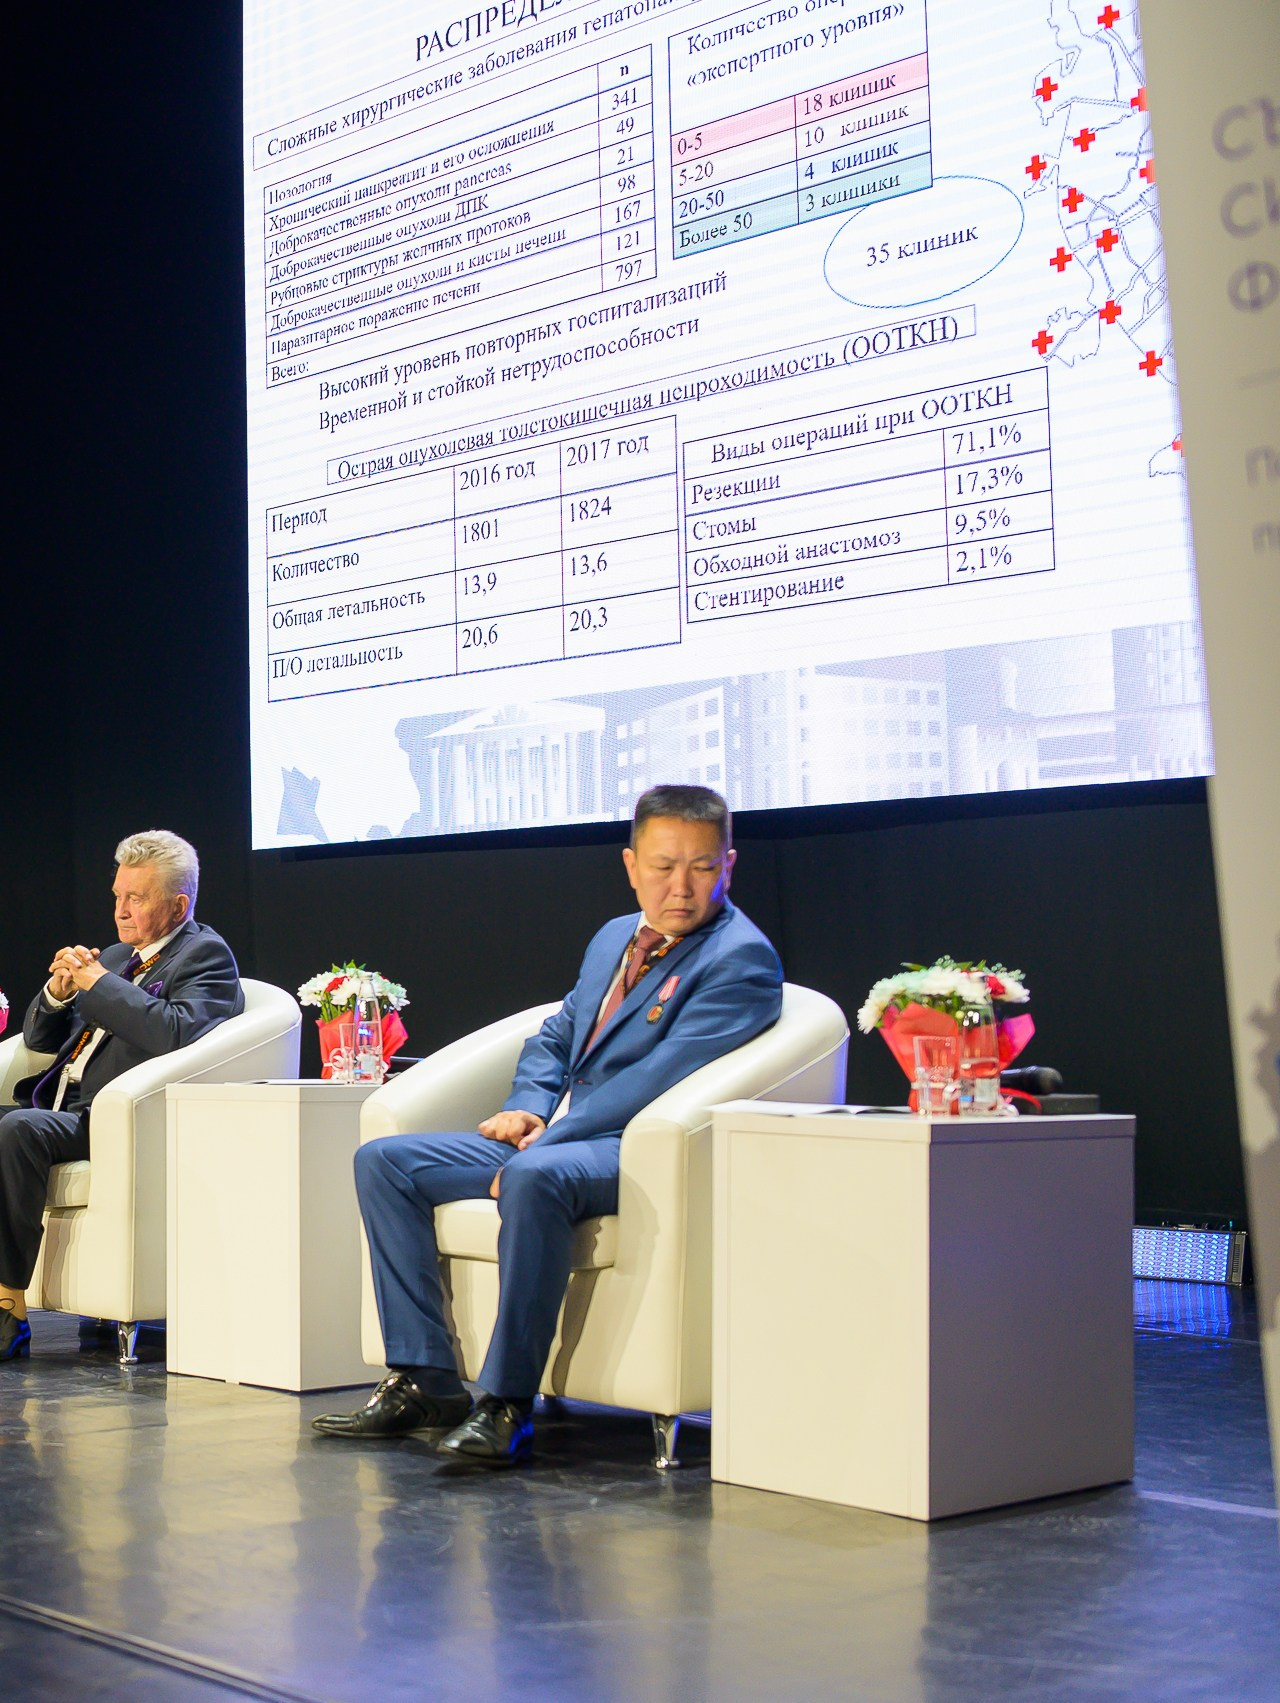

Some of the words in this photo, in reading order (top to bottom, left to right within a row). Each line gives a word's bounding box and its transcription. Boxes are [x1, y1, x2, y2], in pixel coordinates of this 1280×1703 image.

[415, 0, 563, 62] РАСПРЕД
[686, 33, 814, 87] «экспертного
[820, 2, 905, 48] уровня»
[687, 5, 799, 55] Количество
[619, 64, 629, 77] n
[266, 119, 338, 157] Сложные
[341, 70, 464, 128] хирургические
[467, 25, 578, 80] заболевания
[611, 87, 638, 111] 341
[803, 93, 823, 116] 18
[828, 74, 897, 108] клиник
[616, 116, 635, 135] 49
[805, 126, 825, 148] 10
[840, 105, 910, 137] клиник
[616, 145, 634, 166] 21
[677, 131, 703, 156] 0-5
[268, 189, 351, 232] Хронический
[354, 165, 428, 202] панкреатит
[430, 161, 440, 175] и
[442, 152, 465, 169] его
[468, 120, 555, 159] осложнения
[678, 160, 714, 187] 5-20
[803, 161, 815, 180] 4
[831, 141, 899, 174] клиник
[617, 173, 636, 193] 98
[805, 192, 815, 213] 3
[820, 174, 901, 209] клиники
[268, 204, 392, 259] Доброкачественные
[395, 182, 451, 212] опухоли
[615, 199, 641, 224] 167
[678, 189, 725, 219] 20-50
[269, 231, 392, 284] Доброкачественные
[395, 211, 452, 238] опухоли
[454, 193, 489, 222] ДПК
[616, 230, 640, 251] 121
[679, 224, 728, 249] Более
[733, 211, 753, 233] 50
[271, 277, 329, 308] Рубцовые
[331, 253, 399, 285] стриктуры
[402, 233, 463, 263] желчных
[466, 211, 531, 242] протоков
[866, 242, 890, 268] 35
[897, 226, 979, 260] клиник
[270, 283, 393, 333] Доброкачественные
[396, 264, 452, 291] опухоли
[455, 260, 465, 273] и
[468, 246, 511, 269] кисты
[515, 229, 567, 255] печени
[615, 258, 642, 282] 797
[271, 320, 355, 356] Паразитарное
[358, 298, 429, 330] поражение
[432, 282, 481, 306] печени
[319, 364, 389, 401] Высокий
[393, 349, 461, 387] уровень
[464, 320, 562, 361] повторных
[567, 270, 728, 332] госпитализаций
[271, 361, 309, 382] Всего:
[319, 380, 409, 434] Временной
[412, 390, 423, 406] и
[427, 366, 496, 402] стойкой
[501, 318, 700, 383] нетрудоспособности
[336, 454, 395, 487] Острая
[398, 431, 495, 468] опухолевая
[498, 392, 654, 445] толстокишечная
[659, 351, 836, 407] непроходимость
[842, 315, 960, 367] (ООТКН)
[710, 440, 766, 464] Виды
[771, 413, 869, 452] операций
[874, 409, 916, 435] при
[921, 383, 1014, 420] ООТКН
[952, 422, 1022, 455] 71,1%
[566, 438, 611, 468] 2017
[616, 435, 650, 456] год
[459, 463, 501, 491] 2016
[505, 460, 536, 481] год
[691, 474, 781, 505] Резекции
[956, 463, 1023, 496] 17,3%
[272, 507, 328, 535] Период
[570, 495, 612, 523] 1824
[955, 507, 1011, 536] 9,5%
[463, 518, 499, 544] 1801
[692, 516, 757, 541] Стомы
[272, 552, 360, 582] Количество
[571, 551, 608, 577] 13,6
[693, 543, 790, 577] Обходной
[795, 531, 901, 561] анастомоз
[955, 544, 1012, 574] 2,1%
[464, 571, 498, 597] 13,9
[694, 575, 845, 611] Стентирование
[272, 608, 324, 630] Общая
[327, 591, 426, 620] летальность
[569, 606, 608, 633] 20,3
[461, 623, 499, 649] 20,6
[272, 656, 303, 679] П/О
[306, 645, 404, 674] летальность
